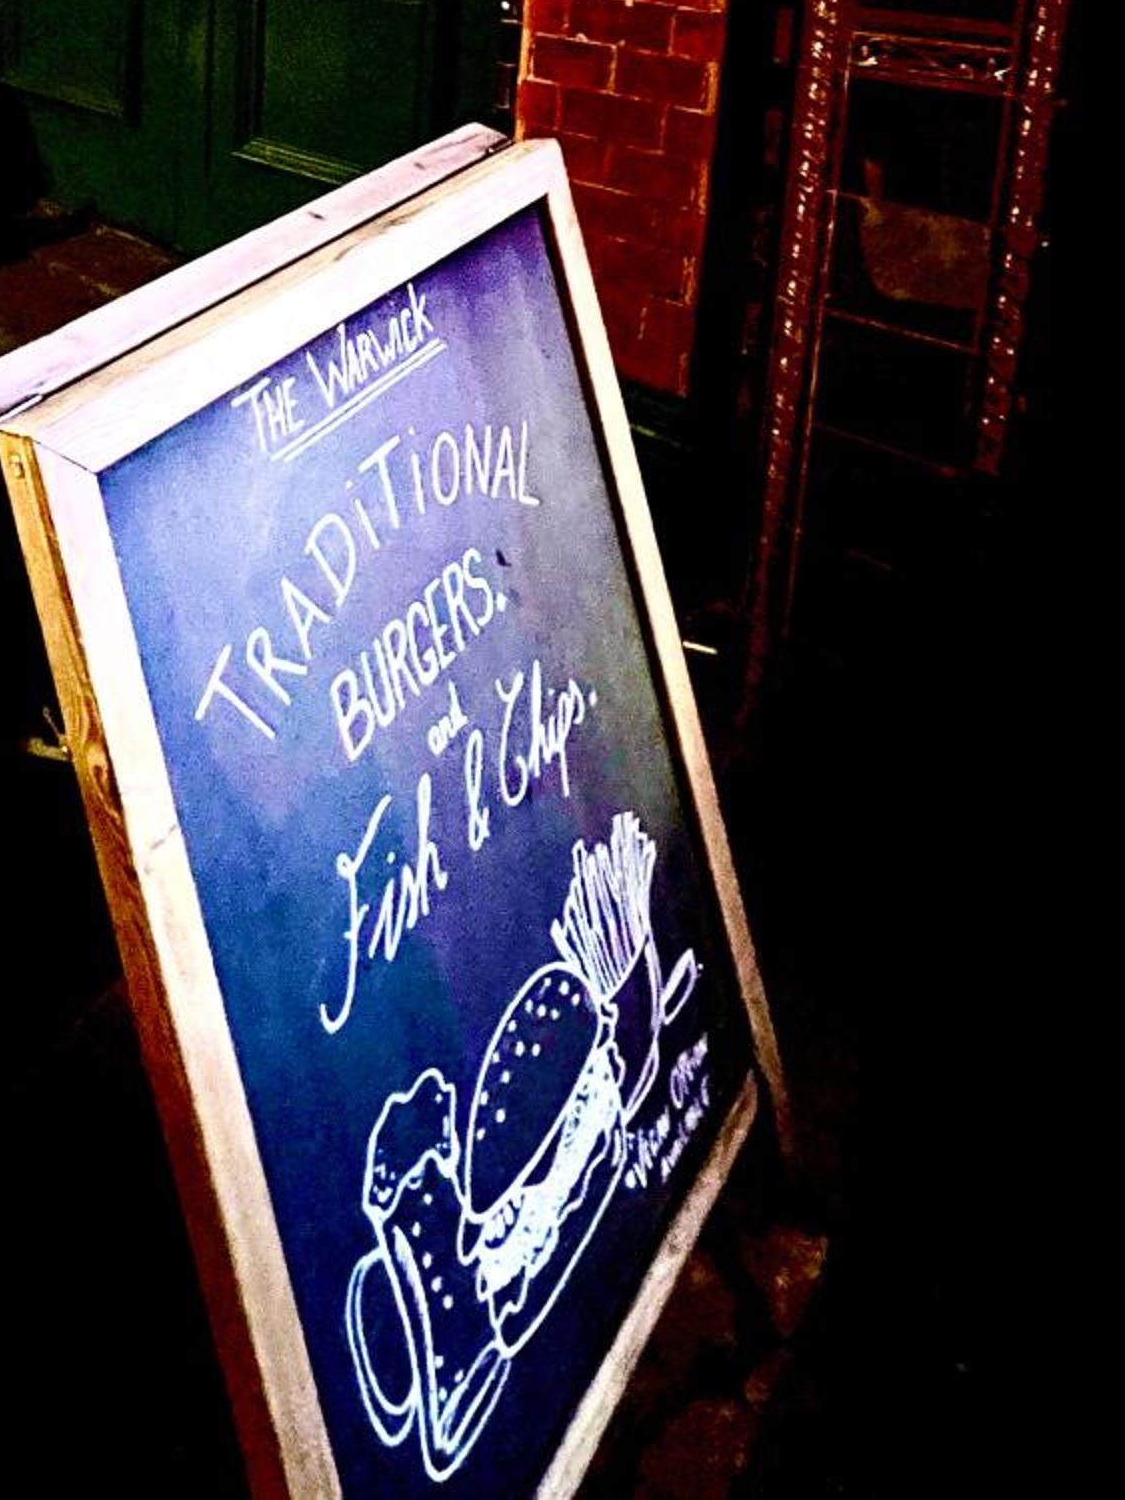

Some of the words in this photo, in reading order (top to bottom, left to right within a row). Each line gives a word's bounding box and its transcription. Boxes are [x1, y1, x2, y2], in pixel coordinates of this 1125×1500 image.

[232, 376, 298, 453] THE
[329, 548, 507, 763] BURGERS.
[427, 681, 469, 755] and
[320, 773, 449, 1035] Fish
[464, 729, 491, 851] &
